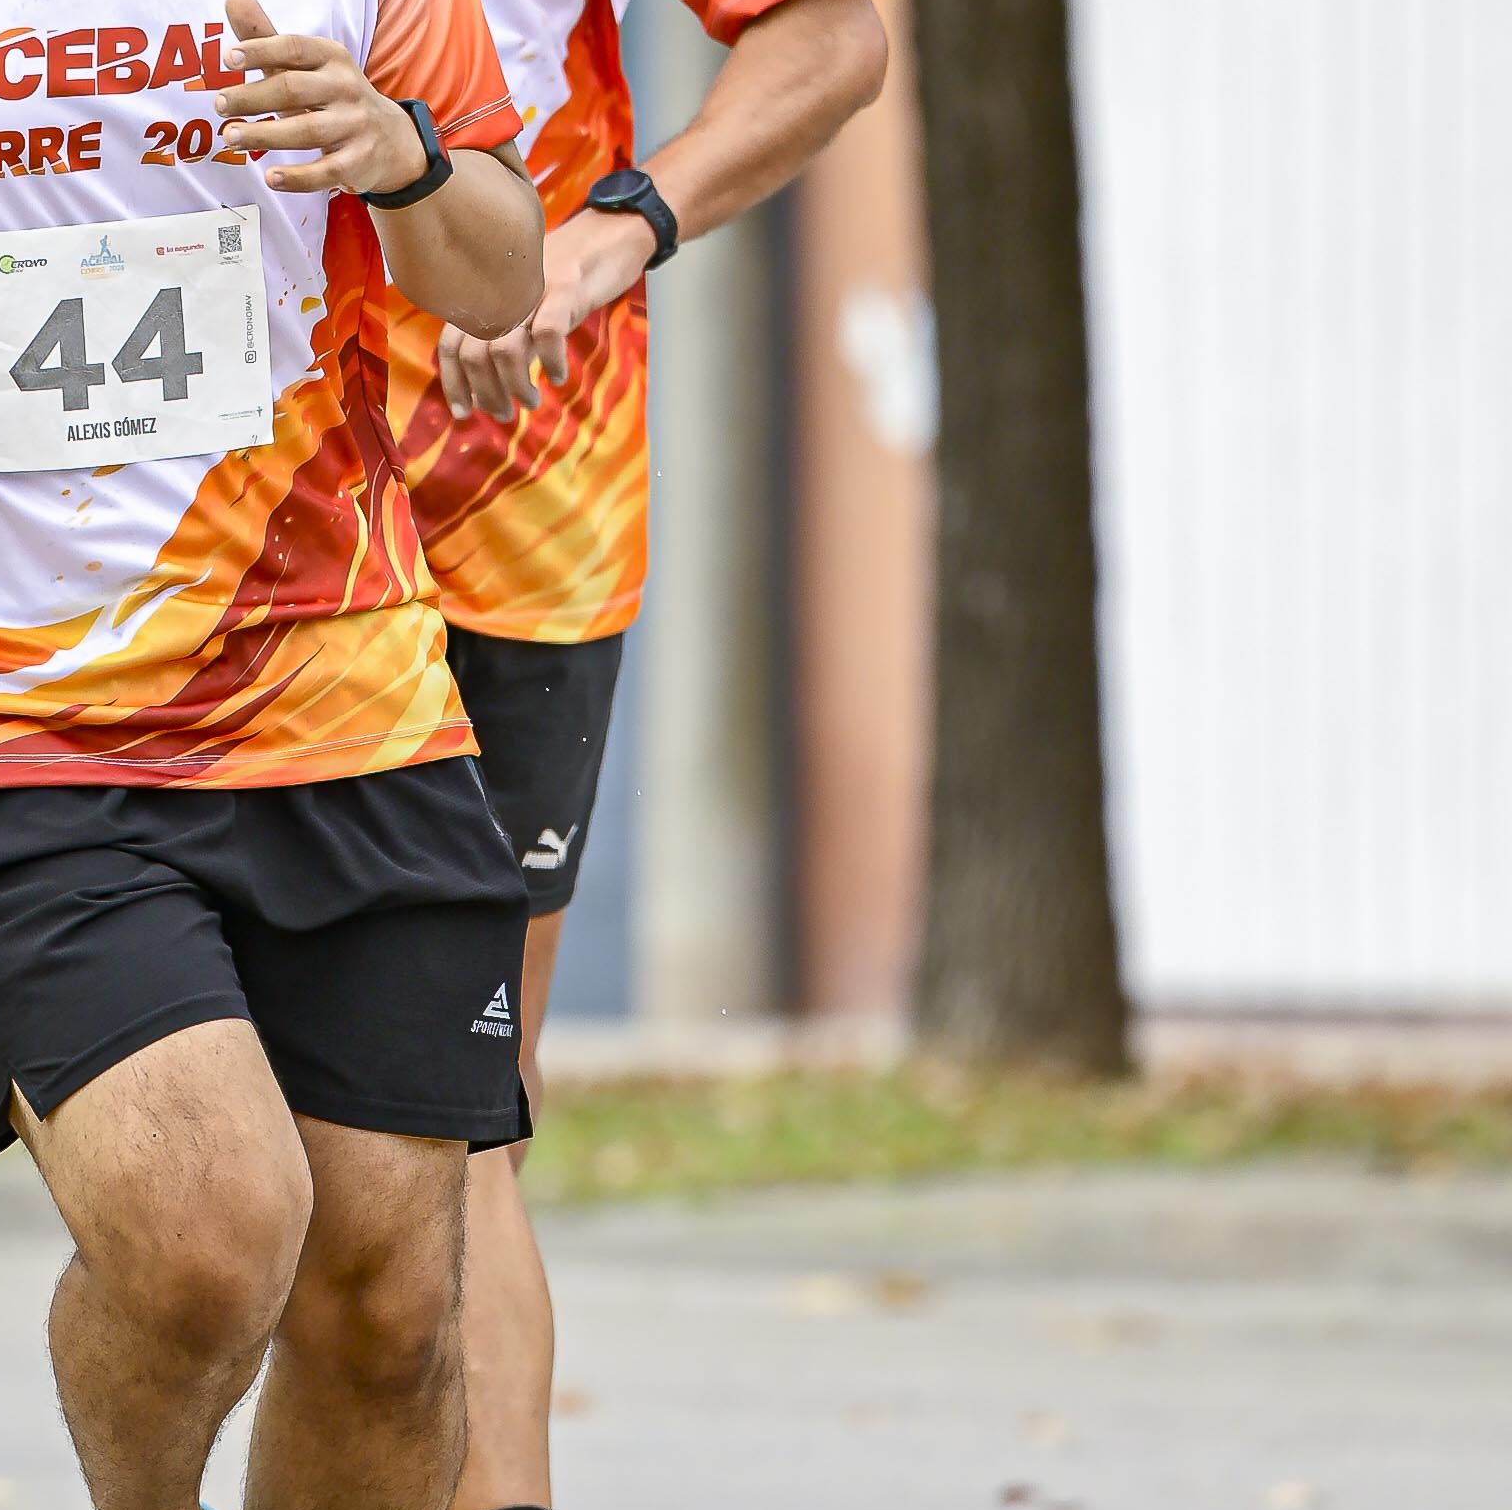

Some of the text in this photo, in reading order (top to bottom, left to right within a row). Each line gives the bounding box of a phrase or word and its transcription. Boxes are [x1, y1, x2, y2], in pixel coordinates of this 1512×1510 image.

[140, 116, 276, 166] 202
[9, 286, 204, 412] 44
[67, 417, 158, 442] ALEXIS GÓMEZ
